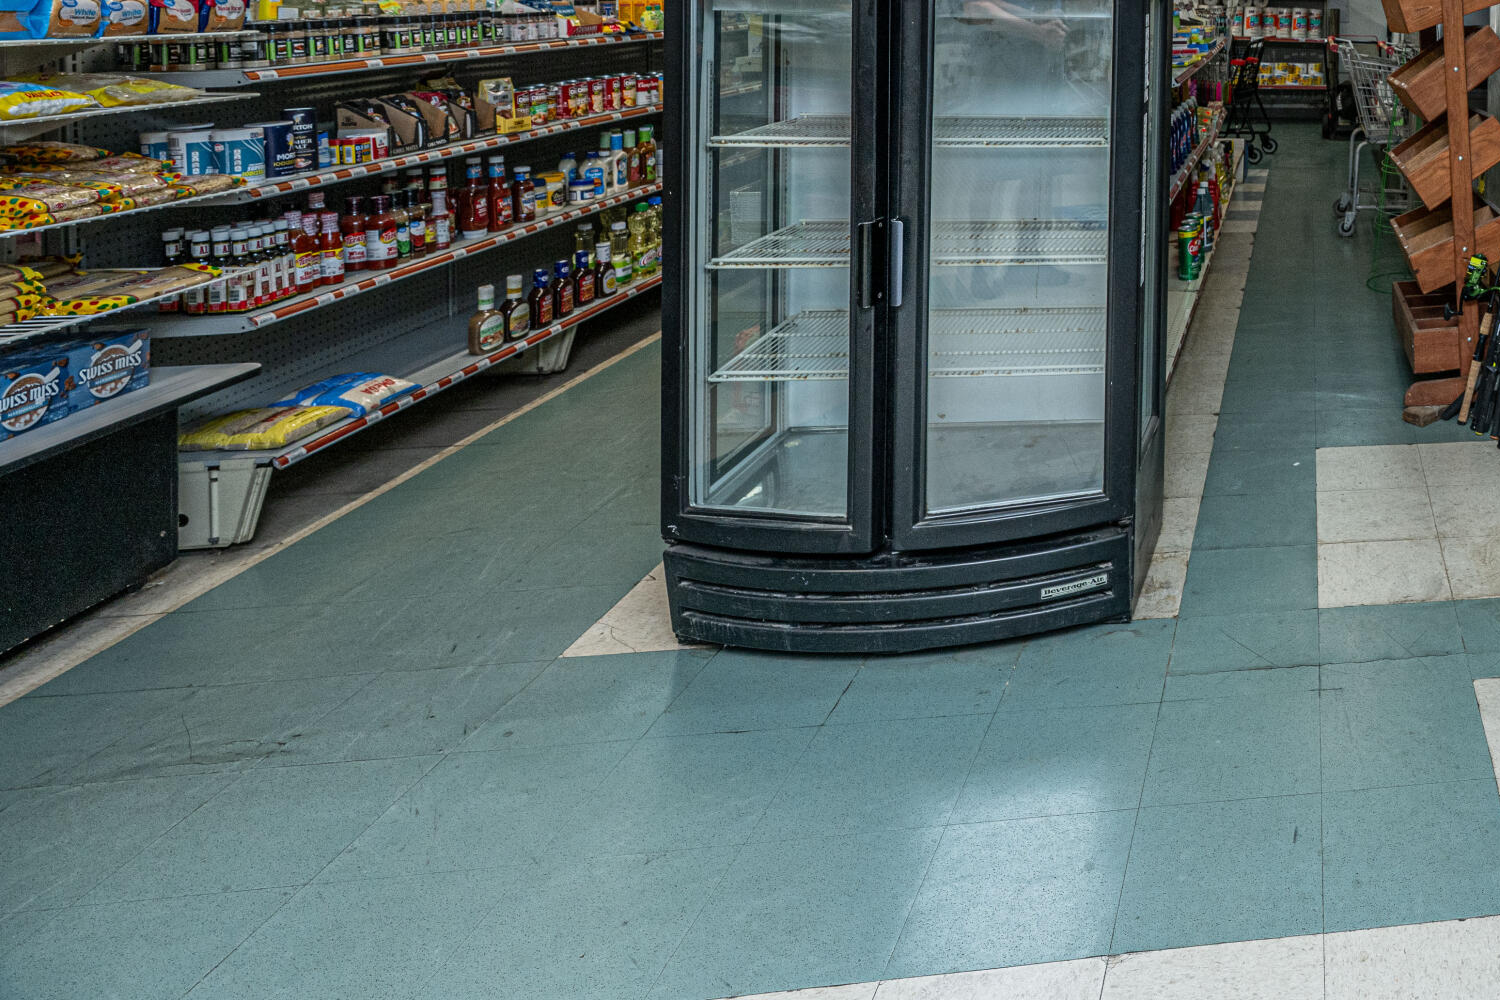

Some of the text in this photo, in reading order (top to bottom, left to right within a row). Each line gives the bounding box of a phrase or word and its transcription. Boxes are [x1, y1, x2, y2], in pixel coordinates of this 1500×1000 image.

[78, 351, 142, 384] SWISS MISS
[0, 380, 59, 413] WISS MISS
